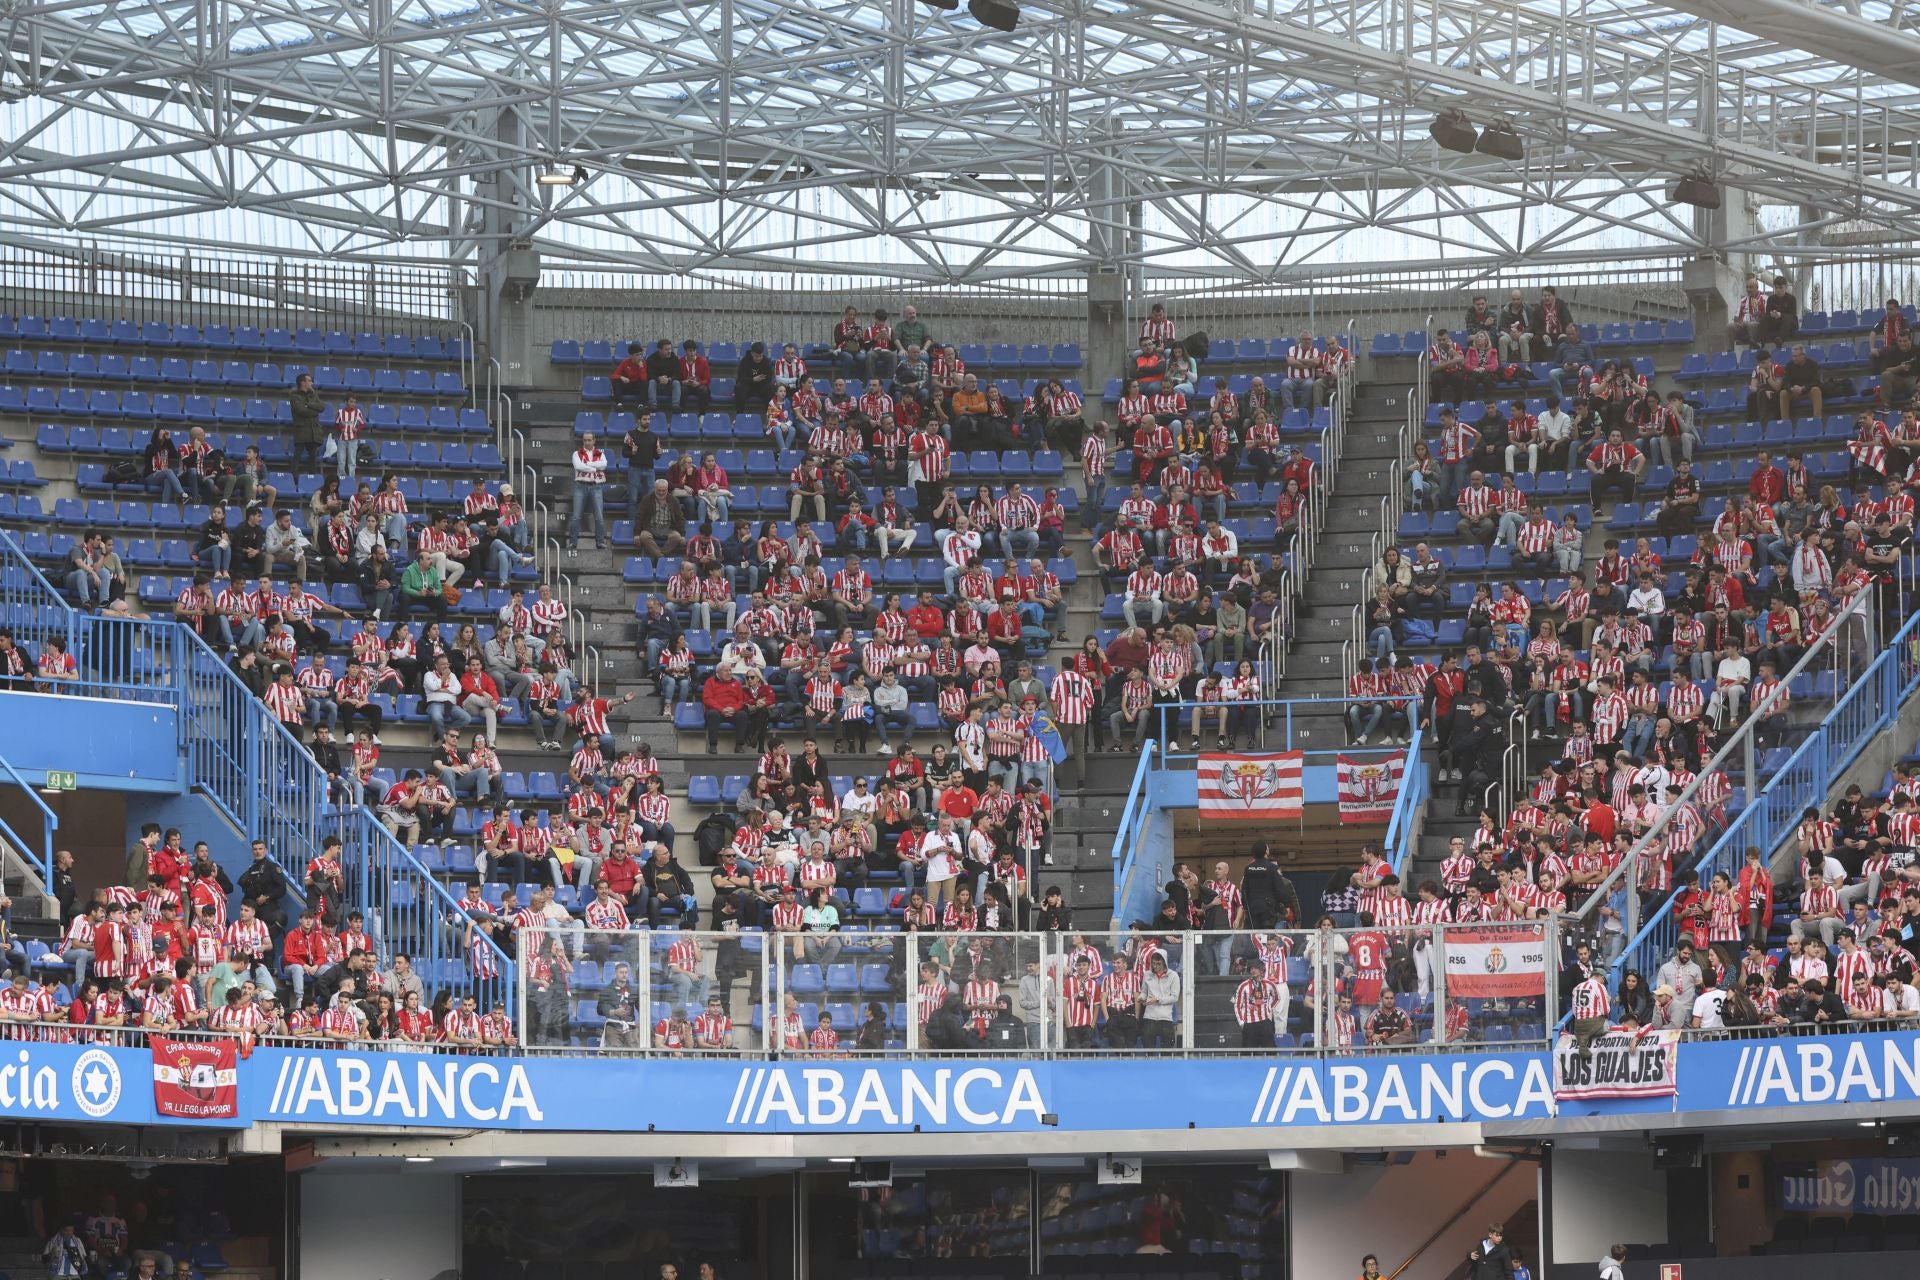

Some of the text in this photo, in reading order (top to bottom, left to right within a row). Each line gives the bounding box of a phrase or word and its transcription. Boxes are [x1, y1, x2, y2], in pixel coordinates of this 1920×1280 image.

[1089, 848, 1096, 856] 8
[1079, 885, 1085, 893] 7
[1359, 944, 1371, 967] 8
[1449, 954, 1543, 965] RSG 1905
[1576, 989, 1591, 1007] 15
[165, 1042, 222, 1058] CASA AURORA
[1560, 1049, 1666, 1086] LOS GUAJES
